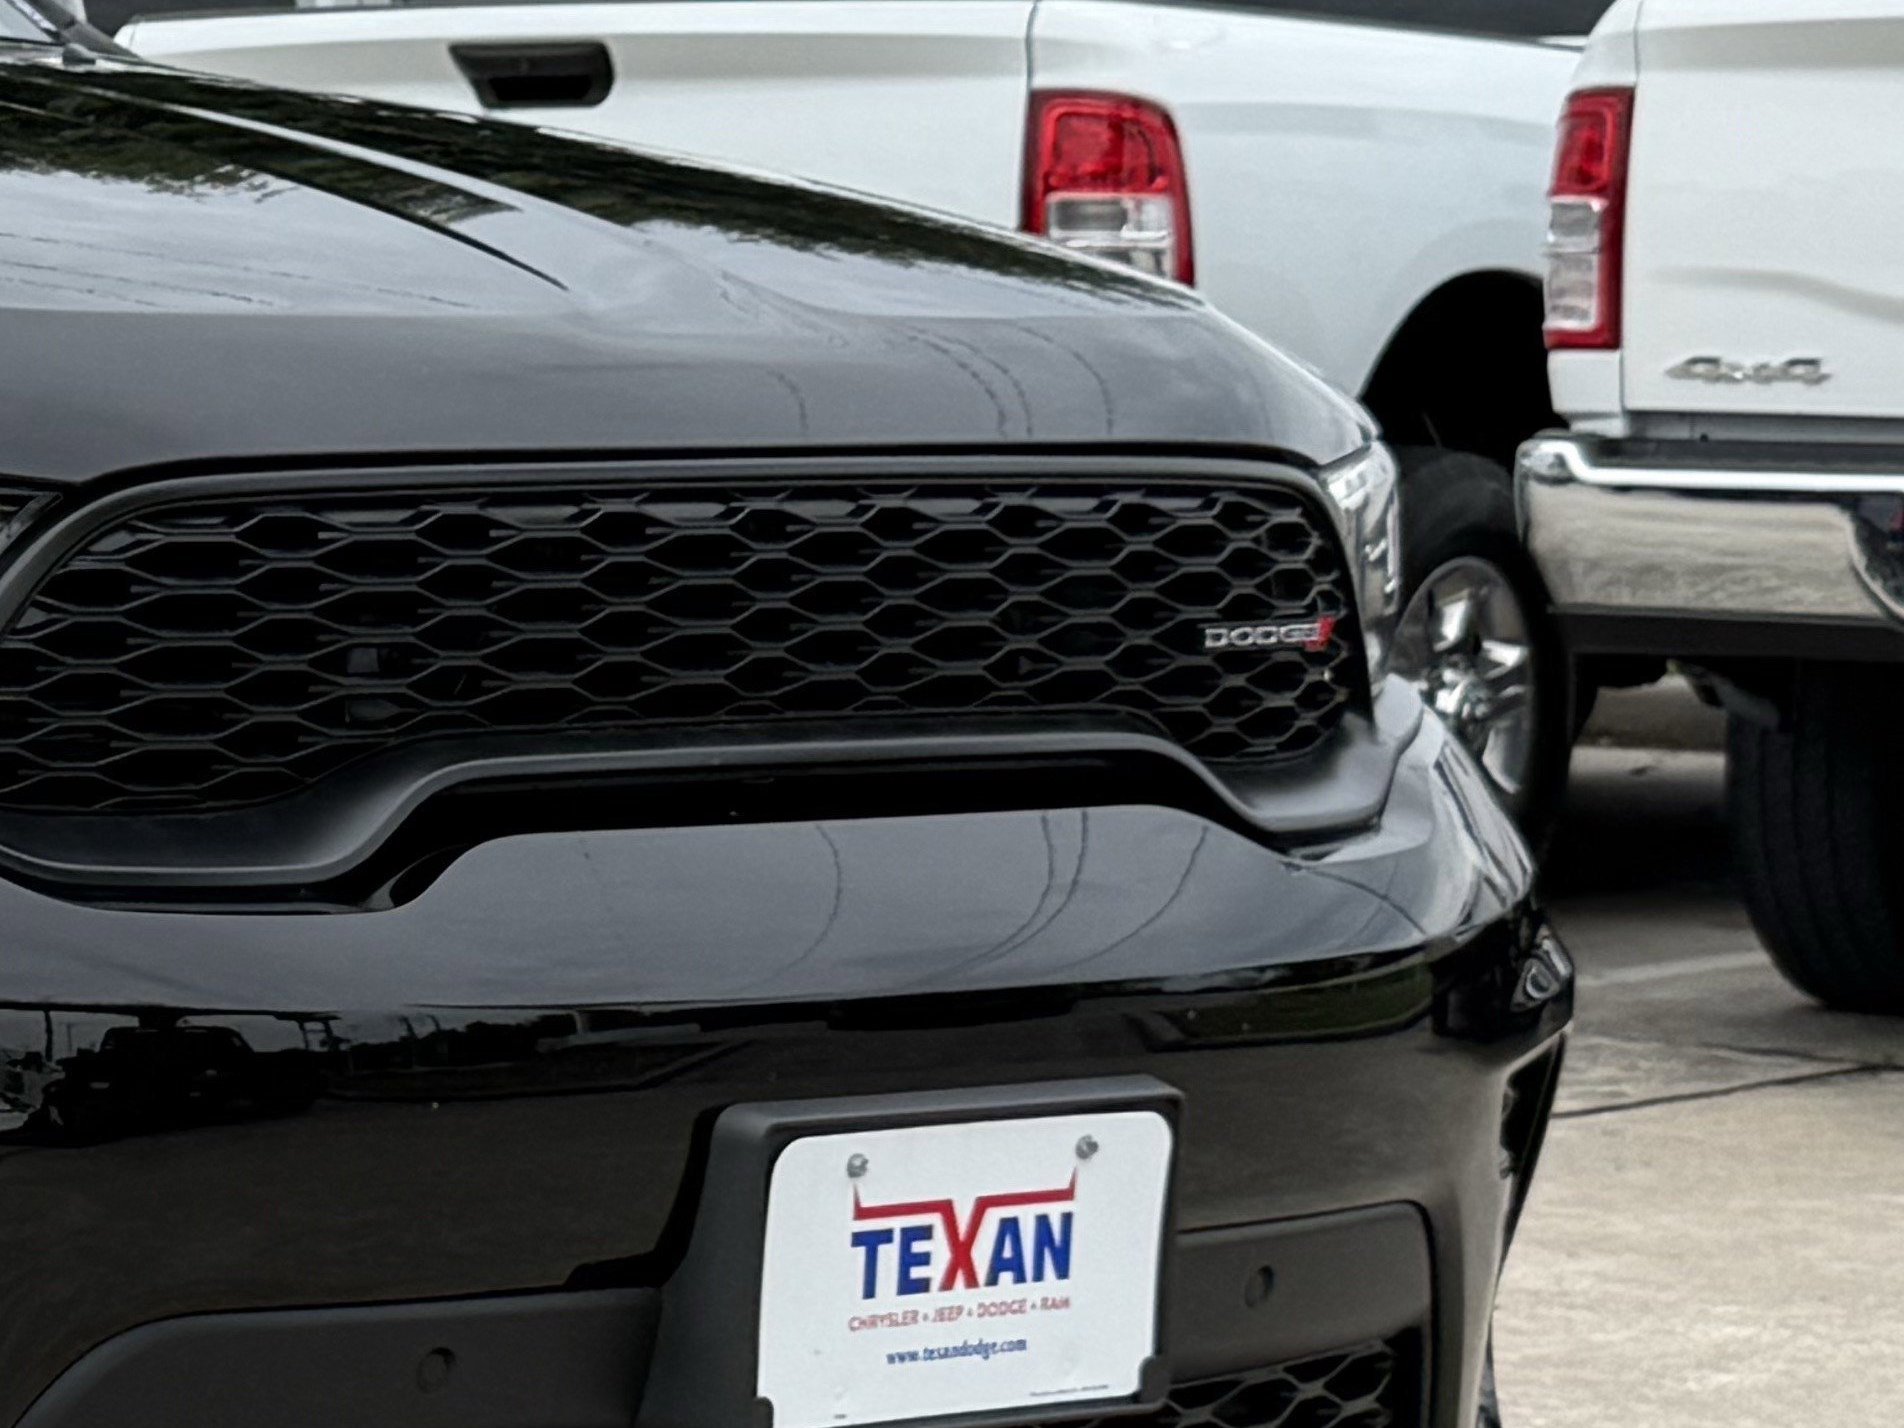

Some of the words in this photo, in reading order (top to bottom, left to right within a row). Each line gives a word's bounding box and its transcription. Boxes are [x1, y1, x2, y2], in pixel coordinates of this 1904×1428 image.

[1204, 623, 1321, 649] DODGE
[850, 1194, 1074, 1301] TEXAN
[848, 1310, 920, 1332] CHRYSLER
[932, 1305, 965, 1324] JEEP
[976, 1299, 1028, 1318] DODGE
[1040, 1297, 1071, 1311] RAM
[886, 1338, 1028, 1365] www.texandodge.com
